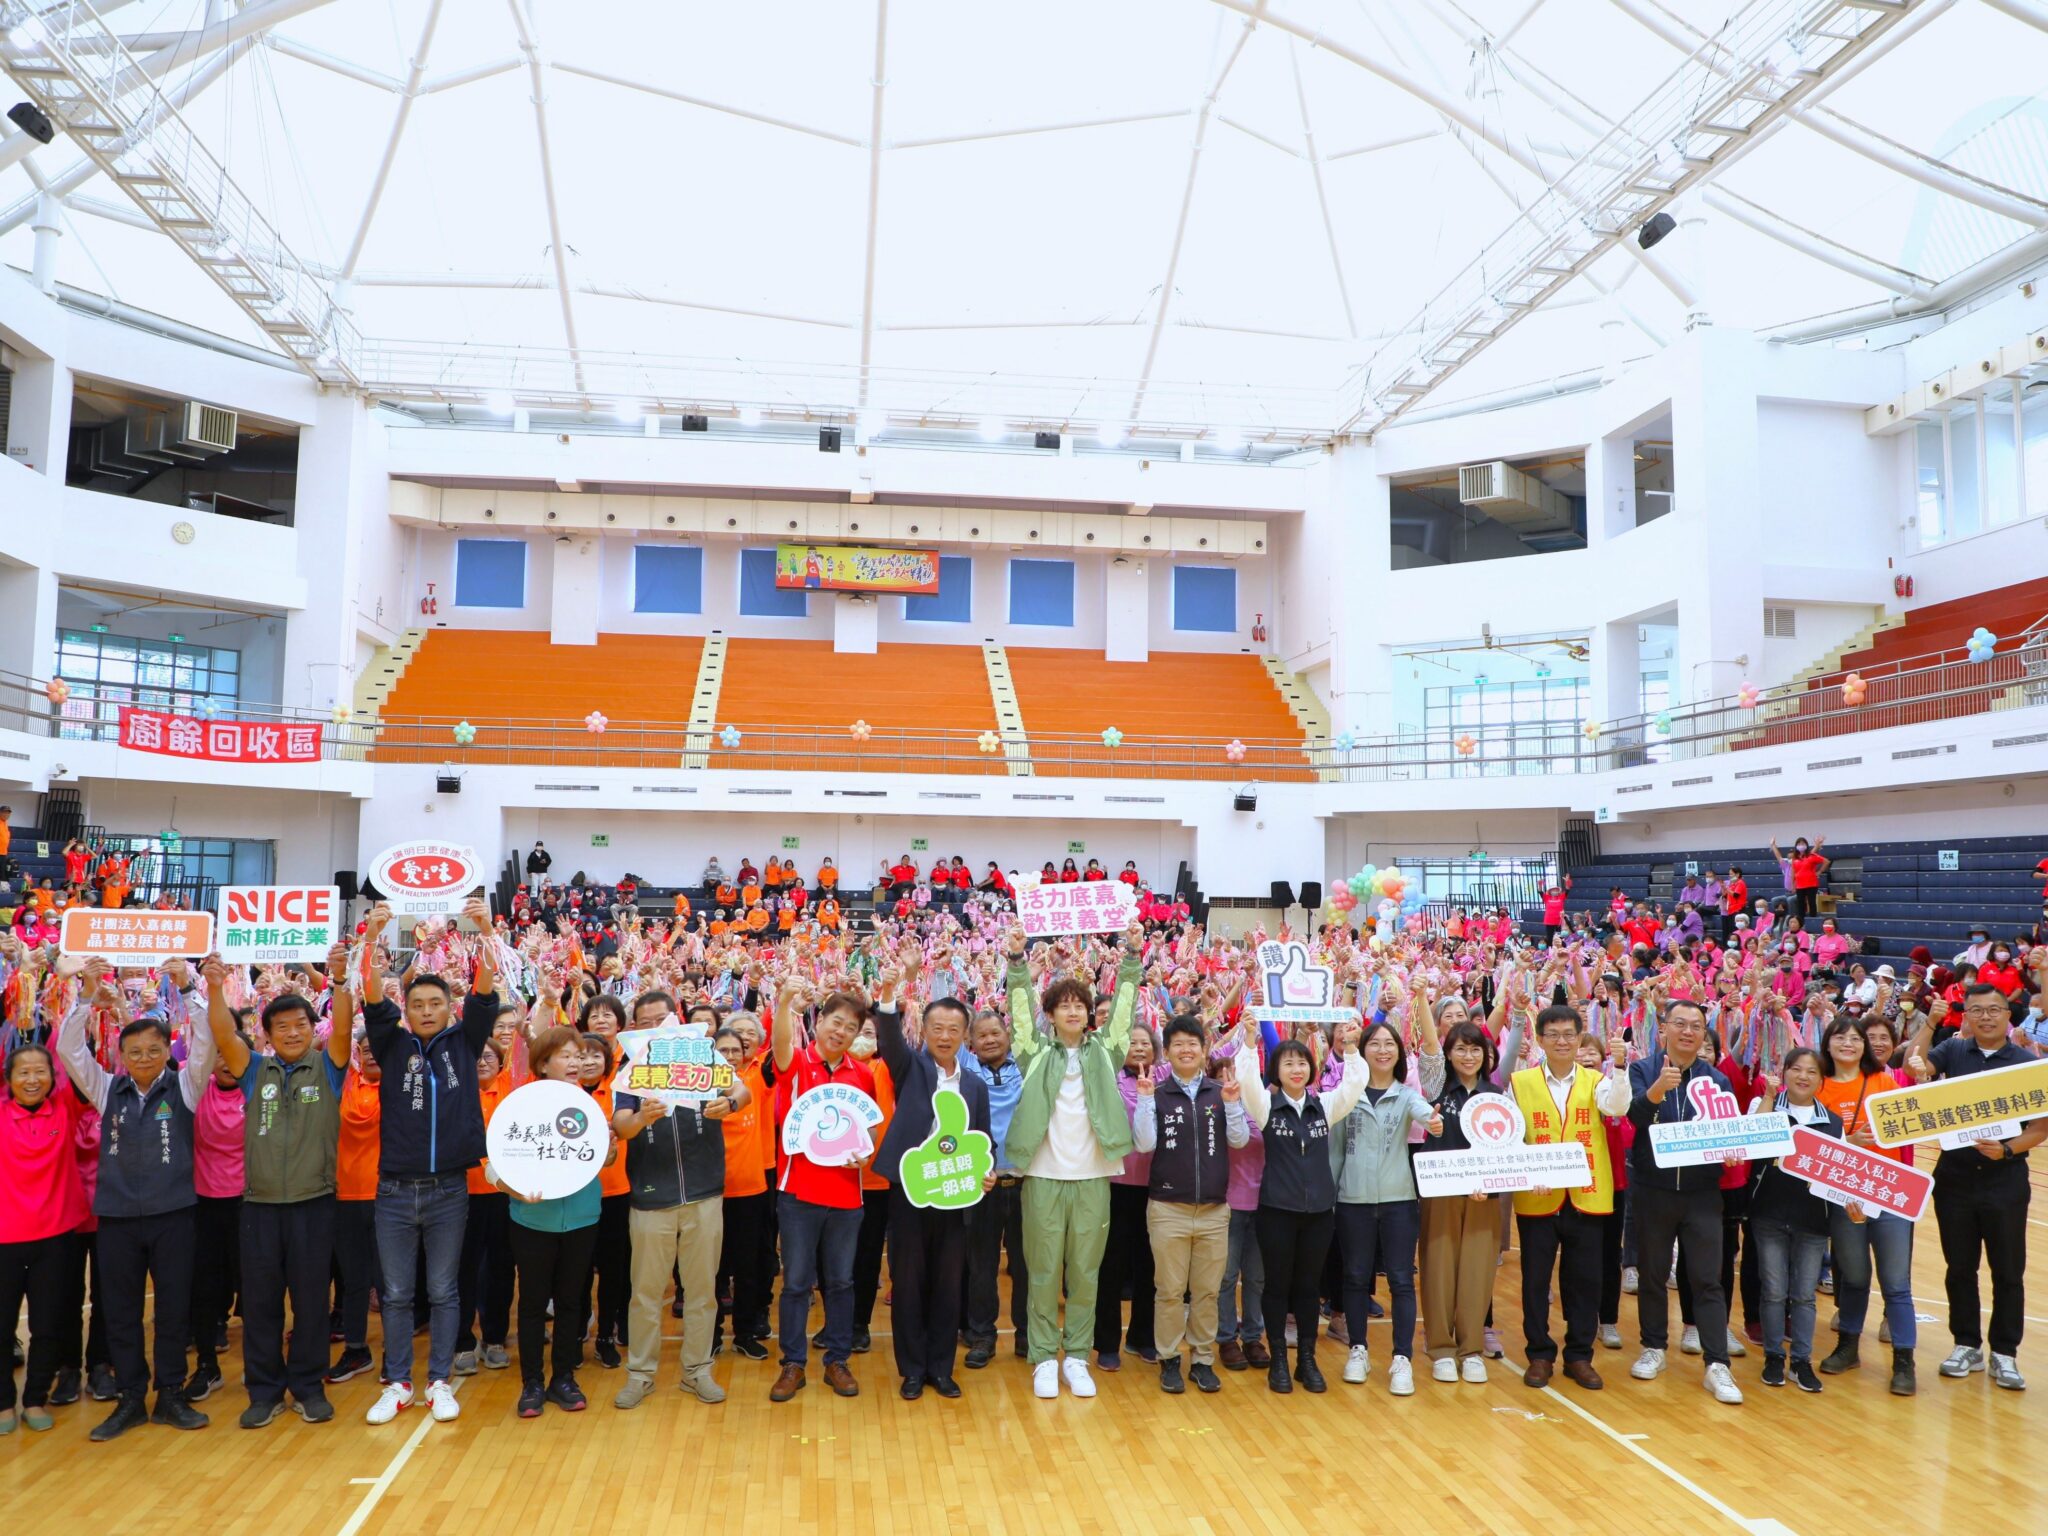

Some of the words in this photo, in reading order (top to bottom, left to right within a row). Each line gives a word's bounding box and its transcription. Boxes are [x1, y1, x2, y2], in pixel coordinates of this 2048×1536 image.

[127, 713, 316, 759] 廚餘回收區
[392, 846, 461, 859] 讓明日更健康
[401, 860, 453, 885] 愛之味
[388, 884, 399, 893] FOR
[432, 884, 465, 896] TOMORROW
[1021, 884, 1117, 910] 活力底嘉
[227, 890, 330, 924] NICE
[89, 917, 187, 932] 社團法人嘉義縣
[1022, 908, 1126, 933] 歡聚義堂
[87, 934, 187, 950] 晶聖發展協會
[226, 927, 329, 947] 耐斯企業
[1261, 944, 1286, 968] 讚
[651, 1040, 711, 1063] 嘉義縣
[630, 1064, 732, 1089] 長青活力站
[788, 1088, 878, 1149] 天主教中華聖母基金會
[1877, 1096, 1920, 1118] 天主教
[1883, 1087, 2048, 1139] 崇仁醫護管理專科學
[504, 1122, 553, 1145] 嘉義縣
[1655, 1114, 1787, 1141] 天主教聖馬爾定醫院
[537, 1140, 595, 1161] 社會局
[1672, 1142, 1701, 1151] MARTIN
[1704, 1140, 1715, 1148] DE
[1717, 1137, 1747, 1146] PORRES
[1751, 1133, 1787, 1144] HOSPITAL
[921, 1154, 973, 1180] 嘉義縣
[1419, 1172, 1433, 1180] Gan
[1444, 1171, 1464, 1179] Sheng
[1479, 1168, 1497, 1176] Social
[1498, 1167, 1523, 1175] Welfare
[1524, 1165, 1548, 1174] Charity
[1550, 1163, 1586, 1171] Foundation
[1817, 1143, 1899, 1185] 財團法人私立
[925, 1175, 977, 1197] 一級棒
[1795, 1154, 1909, 1209] 黃丁紀念基金會
